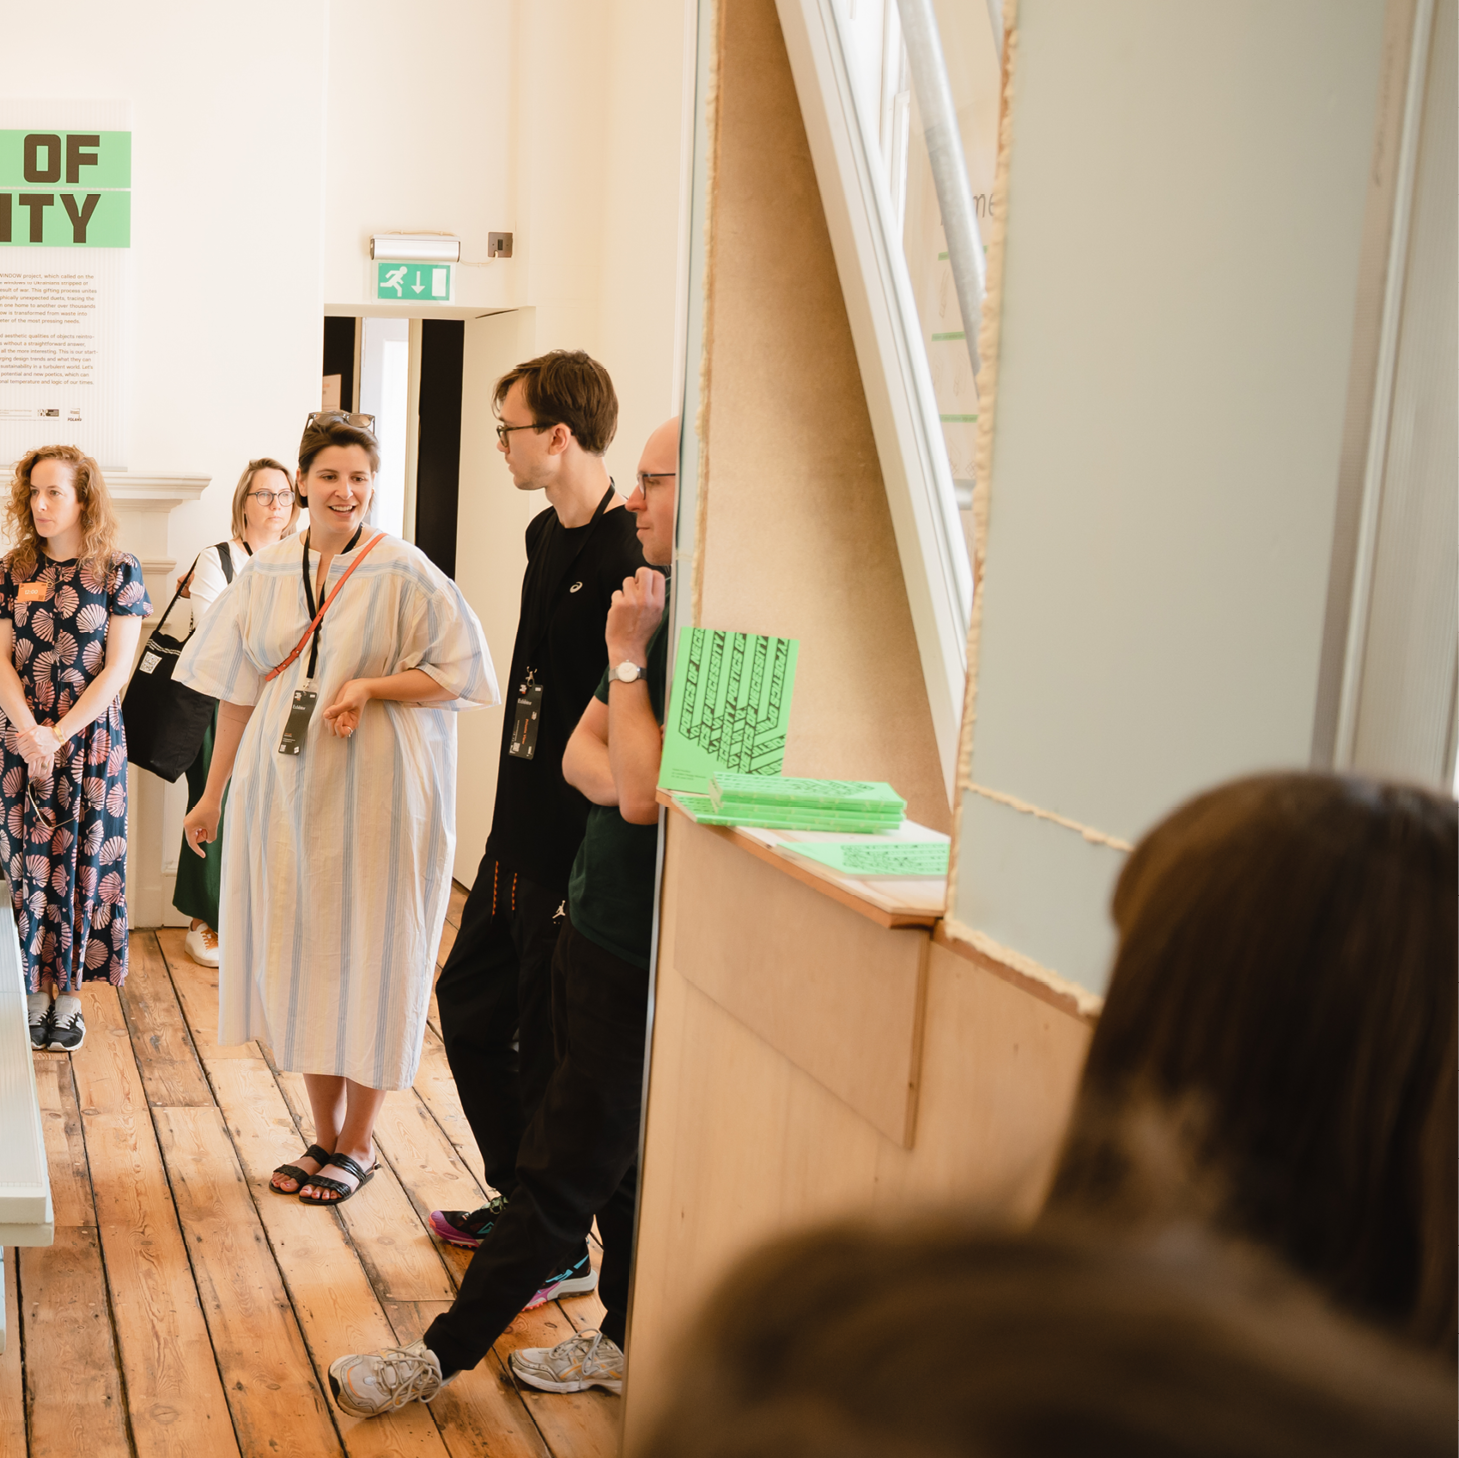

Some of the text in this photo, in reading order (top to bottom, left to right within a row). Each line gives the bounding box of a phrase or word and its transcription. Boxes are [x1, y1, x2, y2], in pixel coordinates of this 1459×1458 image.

[24, 134, 99, 183] OF
[43, 287, 60, 295] gifting
[705, 634, 723, 707] NECESSITY
[727, 652, 742, 705] POETICS
[735, 632, 745, 652] OF
[749, 635, 767, 709] NECESSITY
[770, 655, 785, 707] POETICS
[680, 682, 695, 737] POETICS
[688, 663, 698, 683] OF
[702, 705, 714, 726] OF
[747, 706, 757, 726] OF
